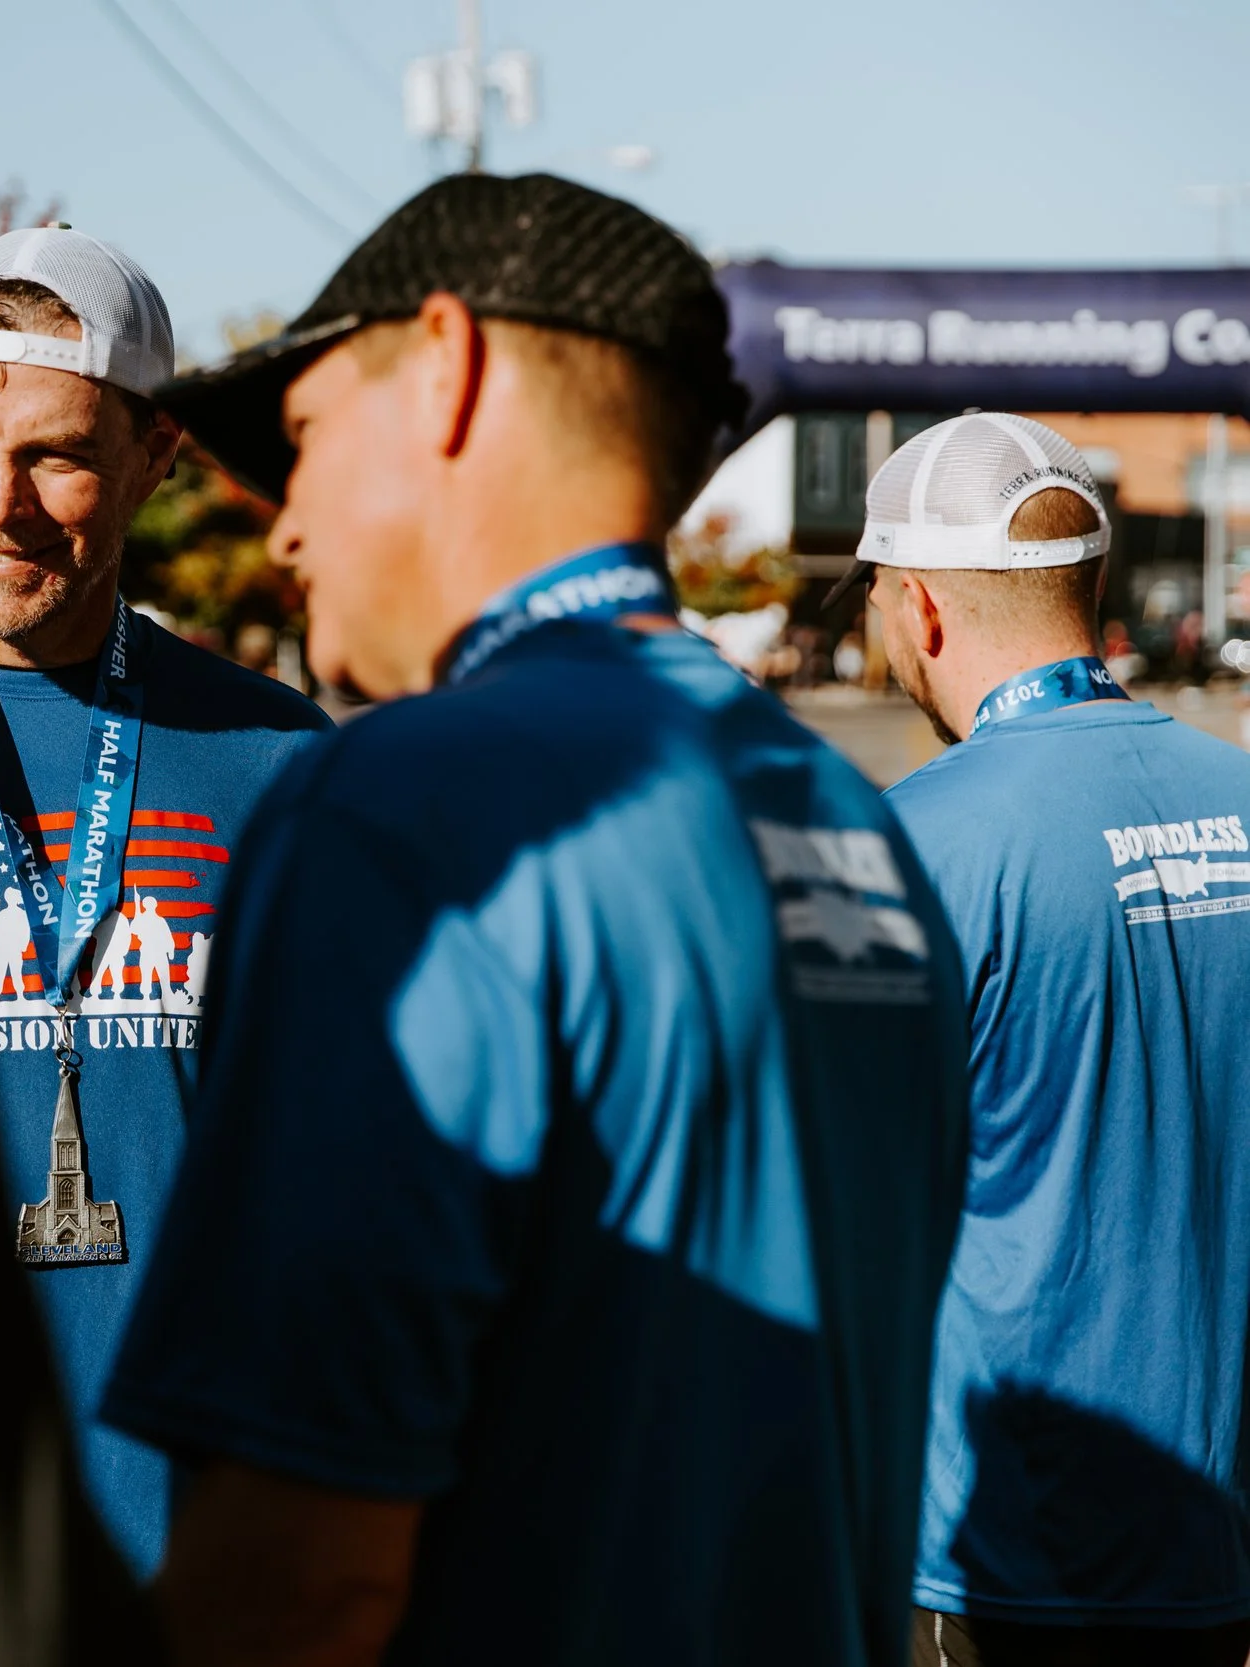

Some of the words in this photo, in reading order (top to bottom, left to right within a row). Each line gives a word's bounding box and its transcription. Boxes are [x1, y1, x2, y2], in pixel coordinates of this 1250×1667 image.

[775, 305, 925, 366] Terra
[927, 308, 1170, 379] Running
[999, 471, 1033, 501] TERRA
[1088, 667, 1119, 686] ON
[993, 679, 1046, 712] 2021
[97, 720, 122, 786] HALF
[1103, 815, 1249, 868] BOUNDLESS
[74, 789, 111, 939] MARATHON
[1130, 907, 1166, 920] PERSONA
[88, 1016, 201, 1050] UNITE
[20, 1241, 123, 1255] CLEVELAND
